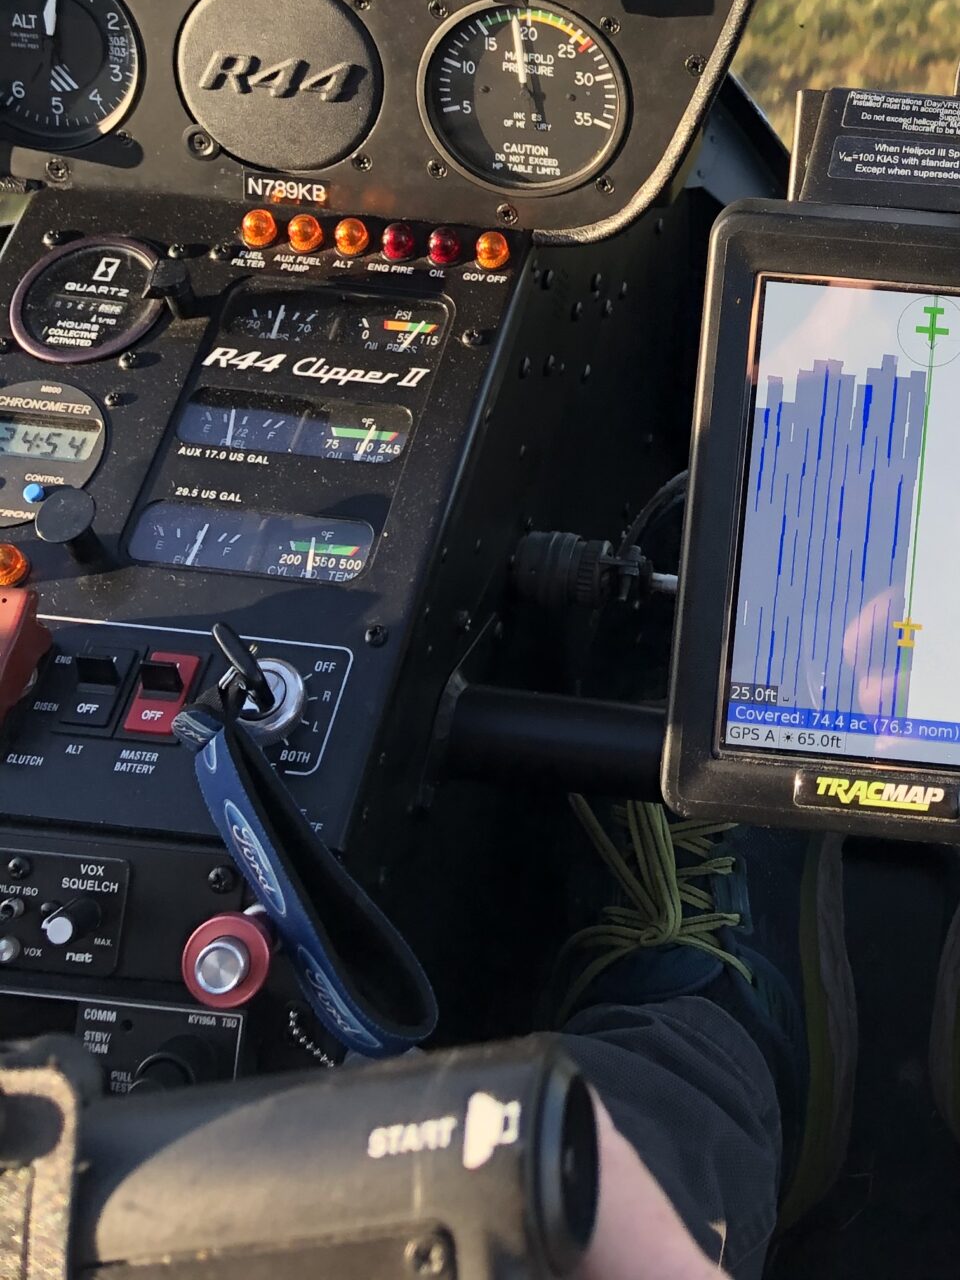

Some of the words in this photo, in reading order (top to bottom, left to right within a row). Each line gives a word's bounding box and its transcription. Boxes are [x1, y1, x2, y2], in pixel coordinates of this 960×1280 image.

[12, 14, 37, 29] ALT
[485, 38, 497, 51] 15
[558, 44, 576, 59] 25
[462, 61, 475, 75] 10
[200, 50, 357, 102] R44
[574, 72, 594, 86] 30
[574, 112, 592, 126] 35
[503, 143, 549, 156] CAUTION
[875, 143, 900, 153] When
[902, 145, 936, 156] Helipod
[937, 148, 946, 156] III
[495, 153, 505, 162] DO
[509, 155, 525, 164] NOT
[529, 157, 558, 166] EXCEED
[877, 154, 900, 164] KIAS
[901, 157, 919, 166] with
[921, 158, 959, 169] standard
[507, 163, 534, 174] TABLE
[536, 165, 561, 176] LIMITS
[855, 164, 886, 175] Except
[887, 166, 911, 176] when
[248, 177, 326, 202] N789KB
[239, 250, 264, 260] FUEL
[273, 254, 295, 264] AUX
[297, 256, 321, 266] FUEL
[231, 258, 265, 269] FILTER
[281, 263, 309, 272] PUMP
[333, 260, 354, 269] ALT
[367, 263, 390, 272] ENG
[391, 265, 414, 275] FIRE
[429, 269, 445, 278] OIL
[462, 272, 485, 282] GOV
[486, 275, 508, 284] OFF
[64, 282, 130, 297] QUARTZ
[395, 310, 412, 320] PSI
[57, 320, 100, 331] HOURS
[48, 328, 98, 340] COLLECTIVE
[46, 336, 92, 347] ACTIVATED
[201, 347, 287, 372] R44
[292, 357, 399, 385] Clipper
[397, 368, 430, 387] II
[0, 395, 92, 416] CHRONOMETER
[324, 439, 340, 449] 75
[377, 443, 401, 455] 245
[178, 447, 202, 457] AUX
[205, 449, 227, 459] 17.0
[229, 452, 245, 462] US
[247, 454, 269, 465] GAL
[24, 473, 65, 485] CONTROL
[175, 487, 199, 497] 29.5
[201, 490, 217, 499] US
[219, 492, 242, 503] GAL
[279, 553, 302, 565] 200
[312, 556, 336, 568] 350
[338, 558, 362, 570] 500
[55, 655, 73, 664] ENG
[314, 661, 337, 673] OFF
[322, 690, 332, 702] R
[731, 686, 778, 702] 25.0ft
[33, 701, 59, 712] DISEN
[76, 703, 99, 714] OFF
[141, 710, 164, 721] OFF
[735, 705, 806, 726] Covered:
[812, 713, 844, 729] 74.4
[850, 718, 868, 731] ac
[873, 718, 914, 738] (76.3
[919, 722, 960, 741] nom)
[729, 726, 760, 743] GPS
[764, 729, 776, 743] A
[798, 733, 842, 749] 65.0ft
[65, 744, 84, 755] ALT
[120, 750, 159, 762] MASTER
[6, 754, 44, 766] CLUTCH
[280, 749, 311, 764] BOTH
[113, 762, 155, 775] BATTERY
[816, 776, 944, 811] TRACMAP
[233, 825, 277, 894] Ford
[80, 864, 105, 876] VOX
[61, 877, 118, 893] SQUELCH
[23, 888, 39, 896] ISO
[23, 947, 42, 957] VOX
[65, 952, 93, 963] nat
[306, 968, 362, 1034] Ford
[84, 1008, 117, 1022] COMM
[222, 1018, 238, 1028] TSO
[84, 1030, 111, 1043] STBY/
[367, 1115, 458, 1159] START
